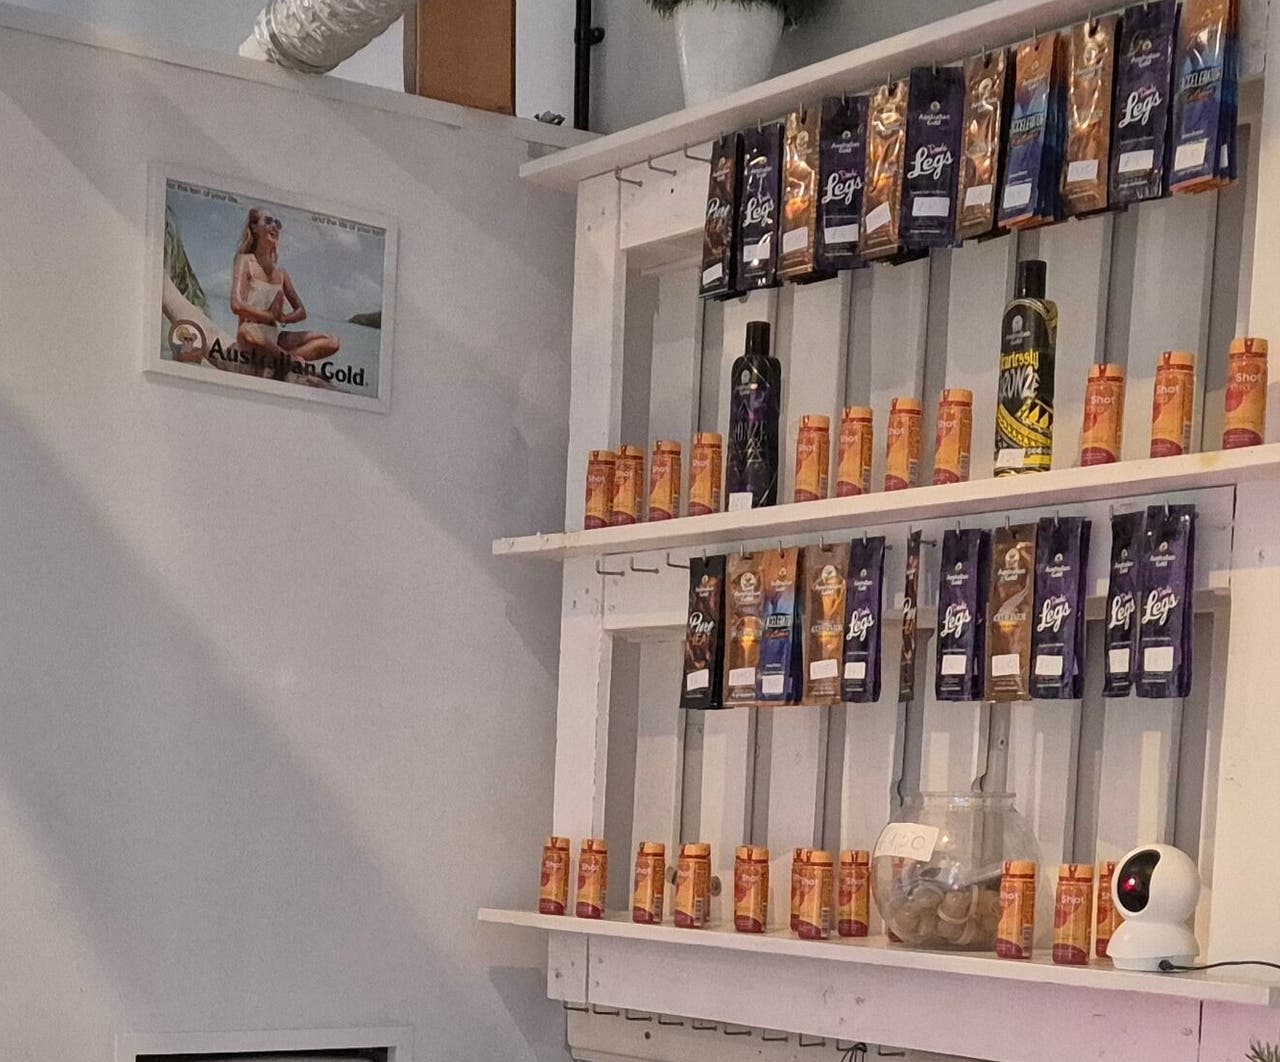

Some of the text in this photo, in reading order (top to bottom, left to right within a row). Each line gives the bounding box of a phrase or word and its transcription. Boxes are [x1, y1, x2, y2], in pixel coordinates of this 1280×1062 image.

[1118, 90, 1163, 128] Legs
[907, 146, 955, 180] Legs
[821, 172, 863, 205] Legs
[1156, 385, 1181, 395] Shot
[1235, 373, 1263, 384] Shot
[1091, 395, 1115, 405] Shot
[689, 611, 715, 635] Pure
[940, 603, 972, 639] Legs
[1036, 599, 1072, 633] Legs
[1108, 595, 1135, 630] Legs
[1141, 589, 1180, 626] Legs
[846, 610, 875, 641] Legs
